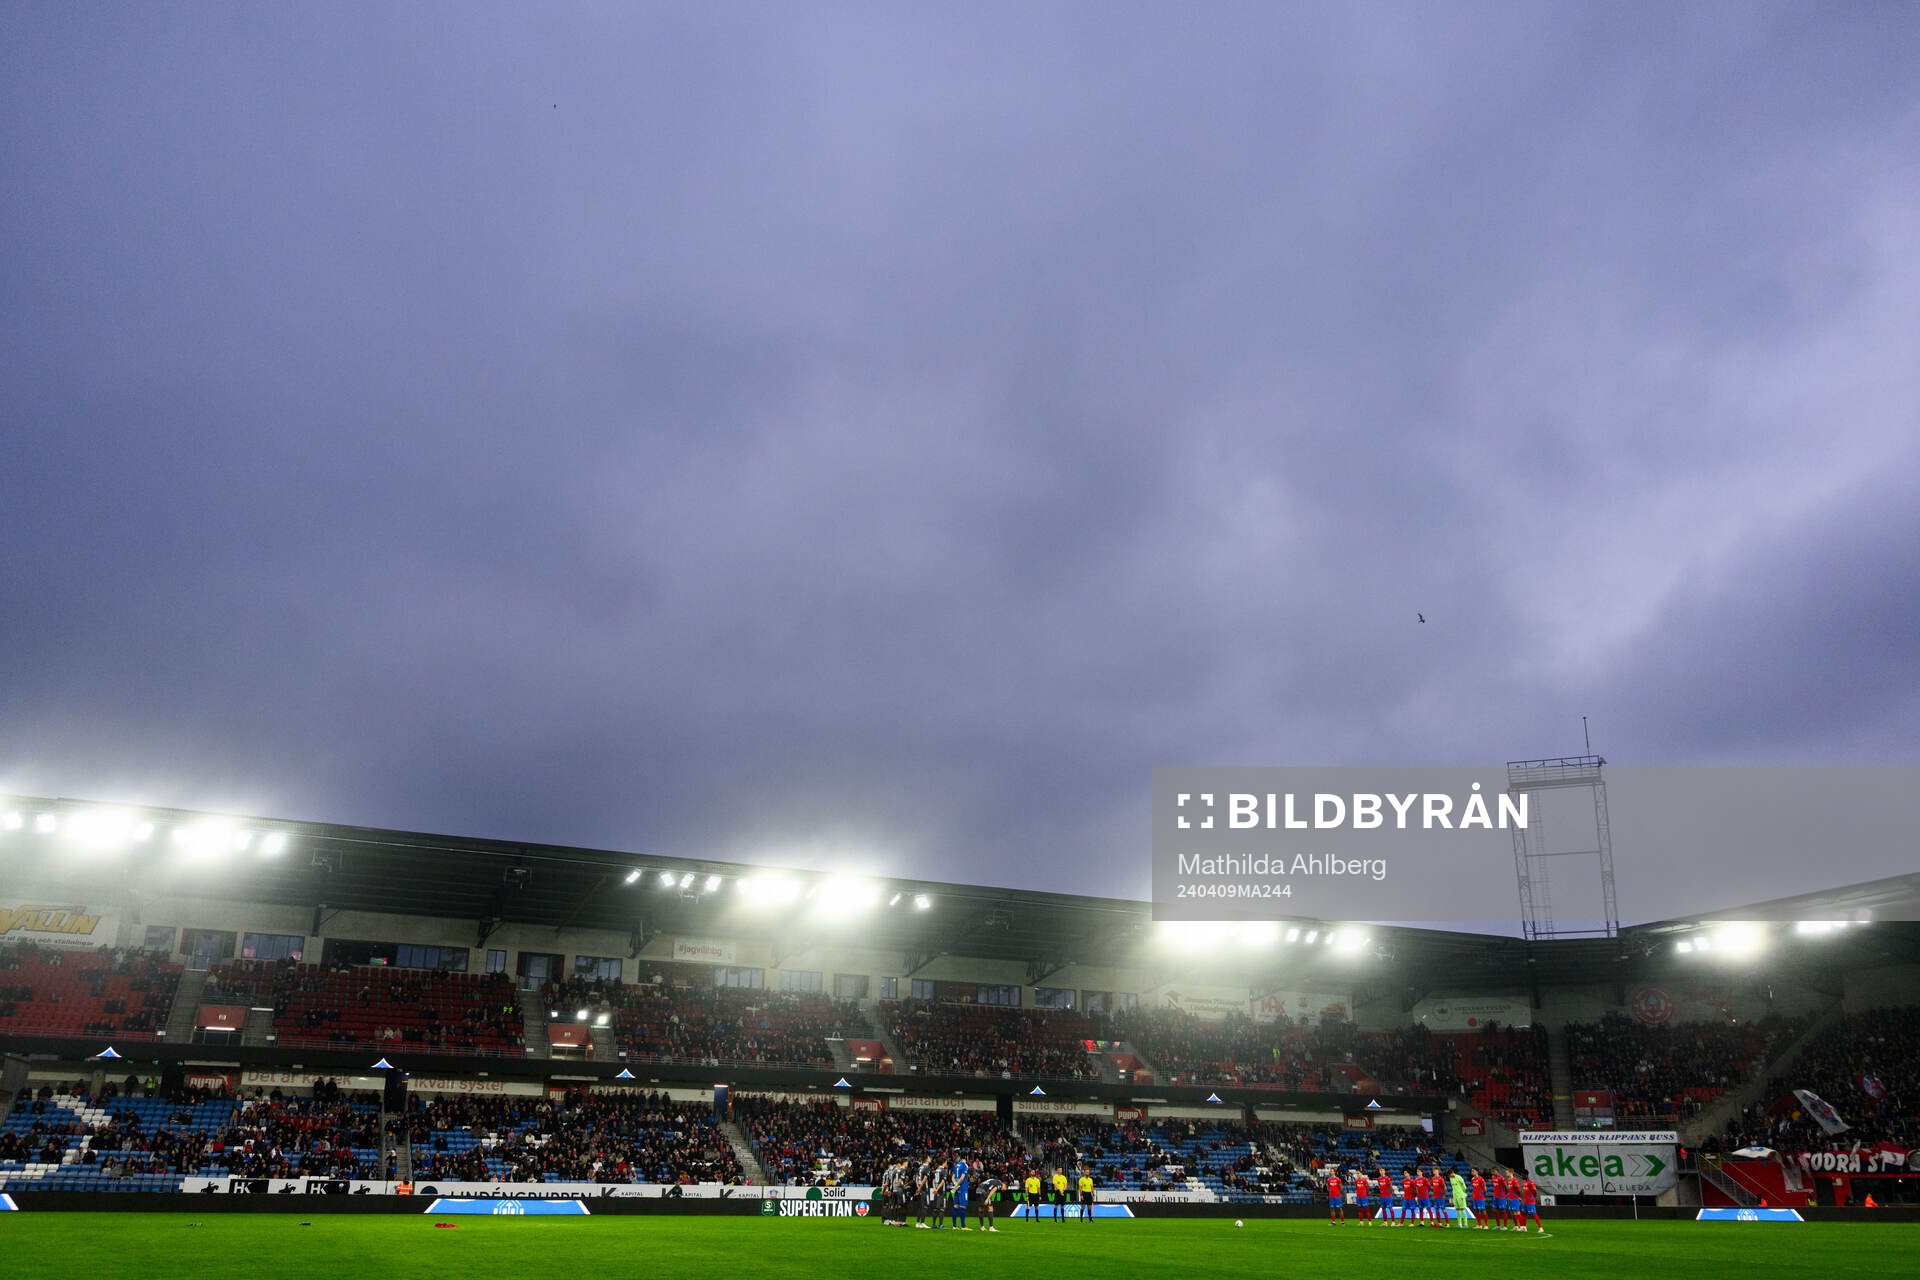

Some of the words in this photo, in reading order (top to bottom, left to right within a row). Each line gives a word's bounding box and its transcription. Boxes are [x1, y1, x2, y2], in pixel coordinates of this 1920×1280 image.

[1534, 1148, 1625, 1177] akea
[823, 1187, 846, 1198] Solid
[1557, 1183, 1581, 1191] PART
[1584, 1183, 1596, 1191] OF
[779, 1200, 852, 1216] SUPERETTAN
